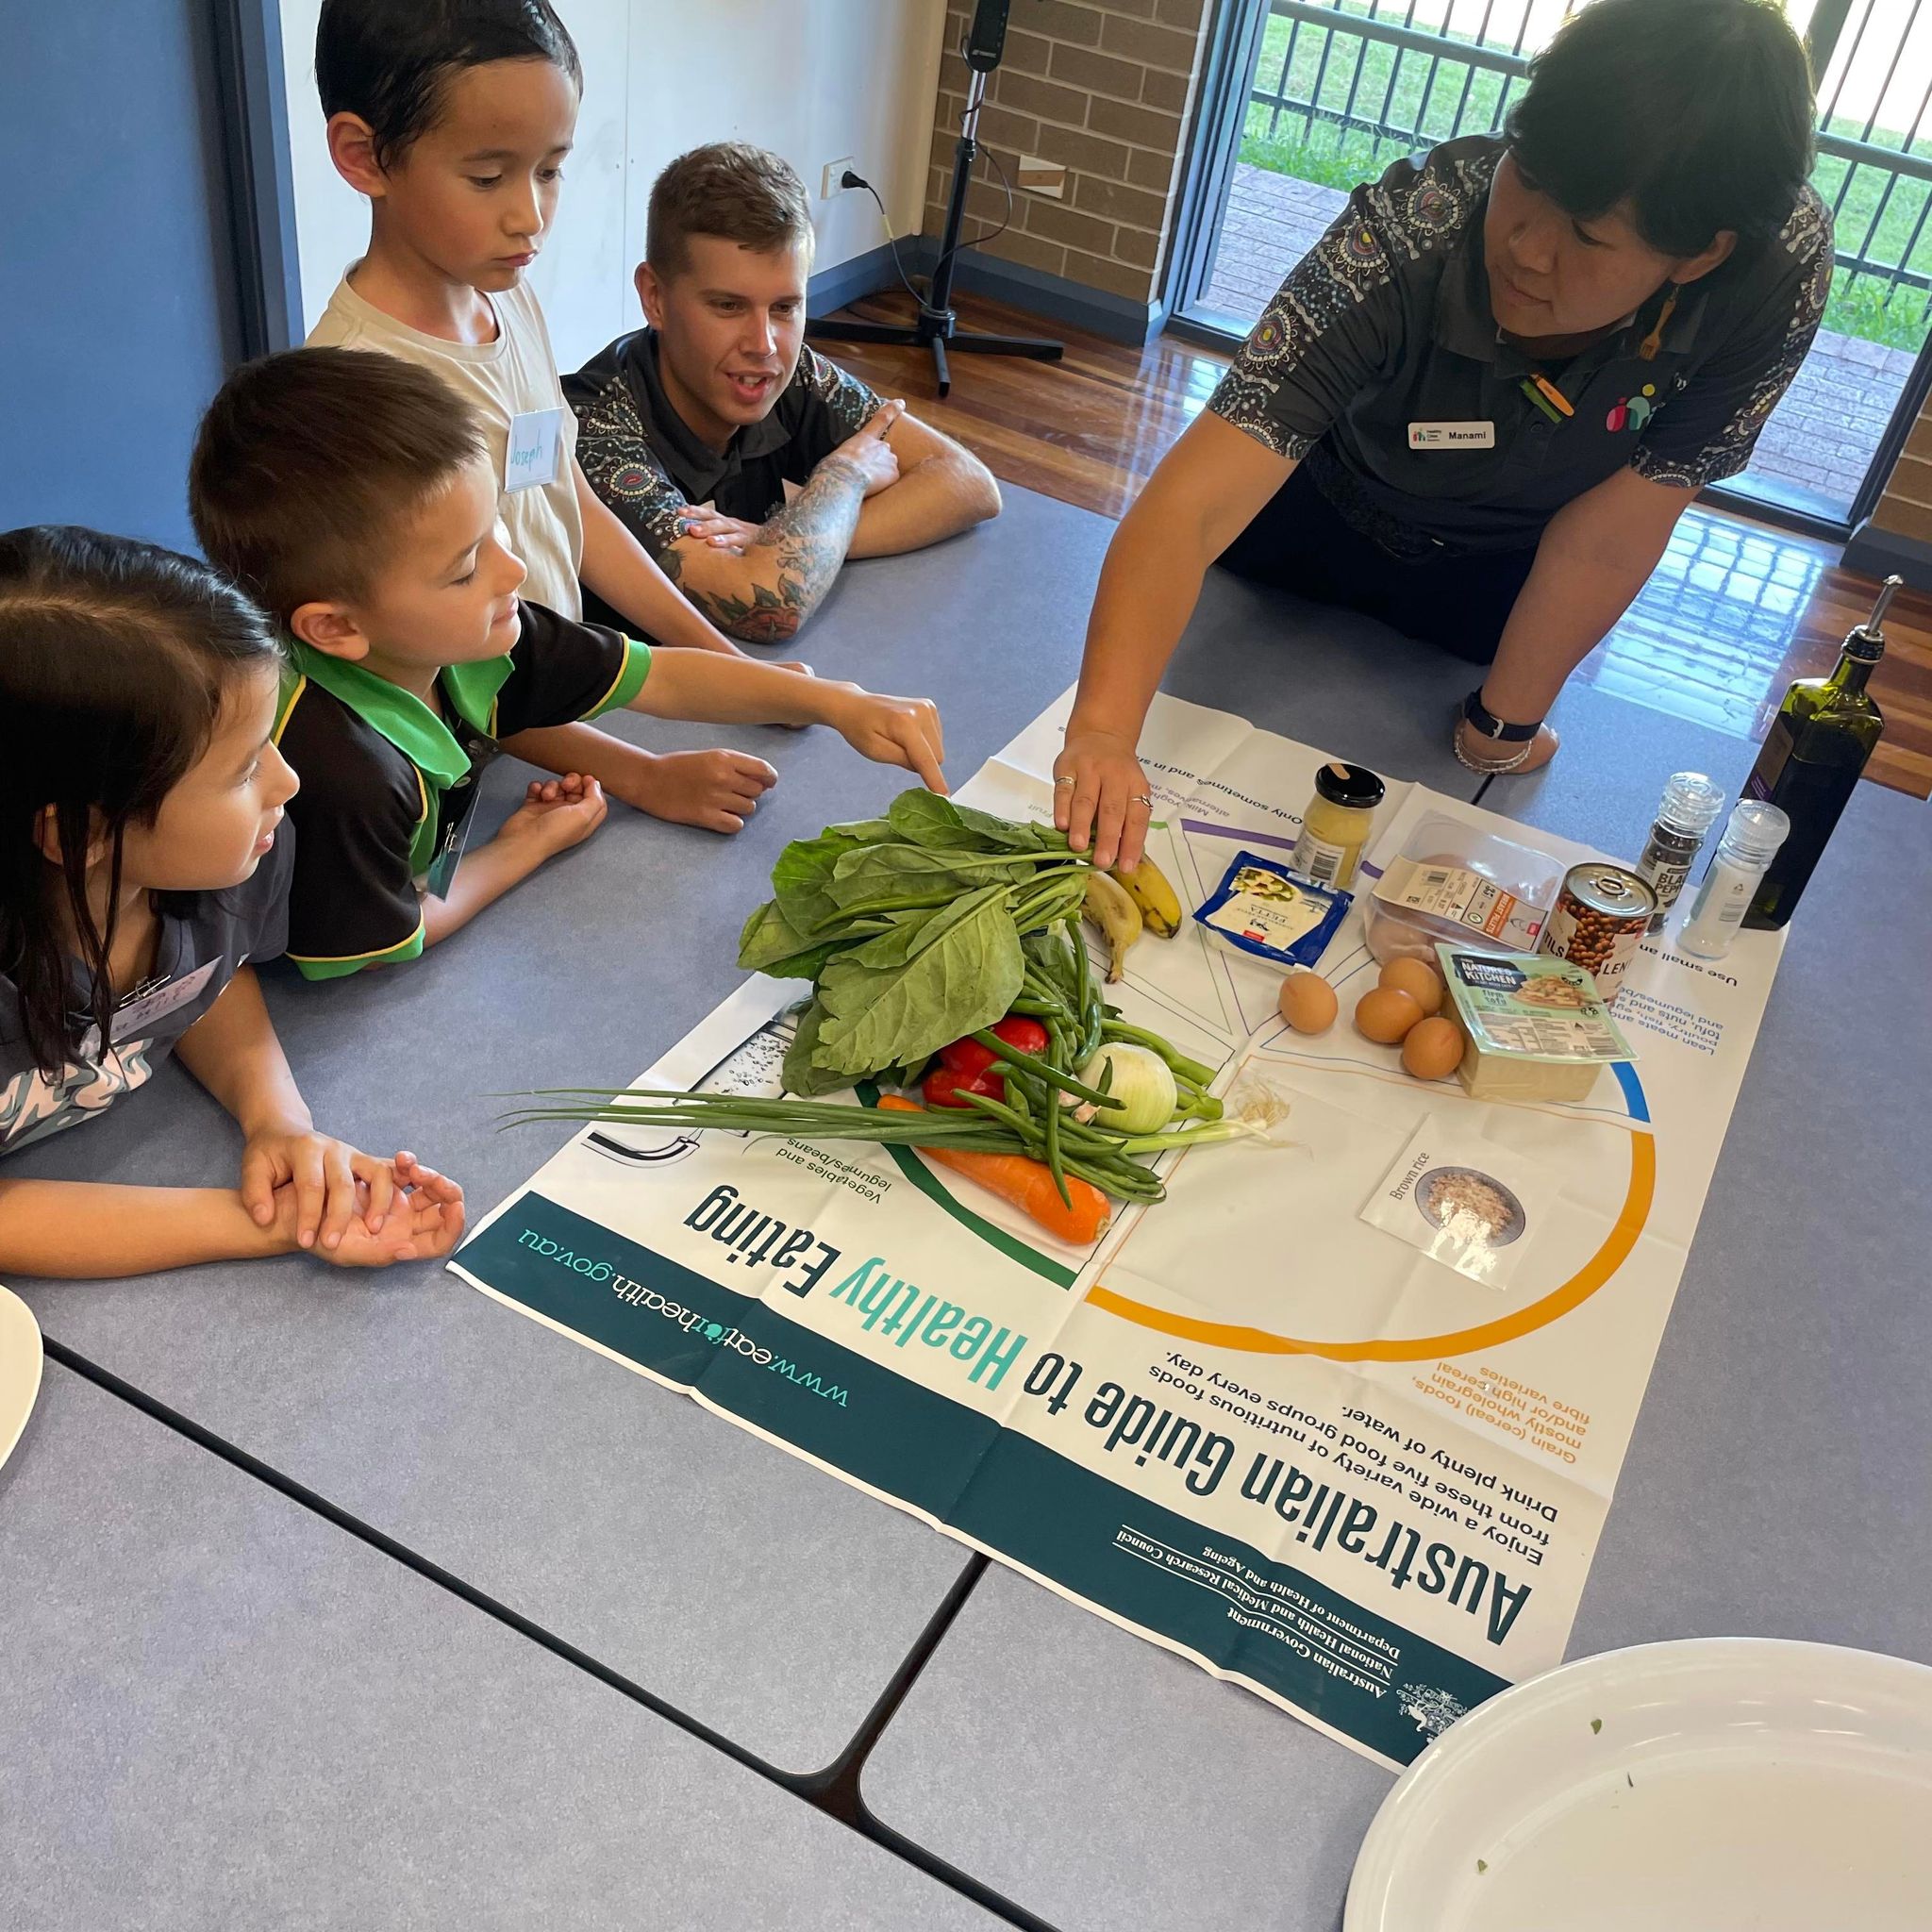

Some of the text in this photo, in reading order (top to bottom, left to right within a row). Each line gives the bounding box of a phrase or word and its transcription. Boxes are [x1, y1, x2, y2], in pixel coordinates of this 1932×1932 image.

[510, 428, 543, 472] Joseph
[1448, 431, 1486, 440] Manami
[1154, 762, 1303, 824] Only sometimes and in
[1251, 908, 1286, 923] FETTA
[1661, 953, 1703, 972] small
[1707, 971, 1738, 987] Use
[1629, 999, 1720, 1041] tofu, nuts and
[1638, 1020, 1678, 1040] meats
[1682, 1038, 1715, 1056] Lean
[1698, 1017, 1724, 1030] and
[775, 1148, 881, 1204] Vegetables and
[787, 1137, 892, 1192] legumes/beans
[1390, 1152, 1429, 1200] Brown rice
[683, 1185, 1532, 1646] Australian Guide to Healthy Eating
[1412, 1376, 1576, 1464] Grain (cereal) foods,
[1432, 1374, 1581, 1449] mostly wholegrain
[1437, 1362, 1587, 1436] and/or high cereal
[1479, 1367, 1590, 1424] fibre varieties
[1149, 1366, 1543, 1566] Enjoy a wide variety of nutritious foods
[1166, 1352, 1549, 1545] from these five food groups every day.
[1342, 1407, 1558, 1523] Drink plenty of water.
[1116, 1530, 1393, 1679] National Health and Medical Research Council
[1202, 1546, 1400, 1659] Department of Health and Ageing
[1227, 1607, 1387, 1698] Australian Government
